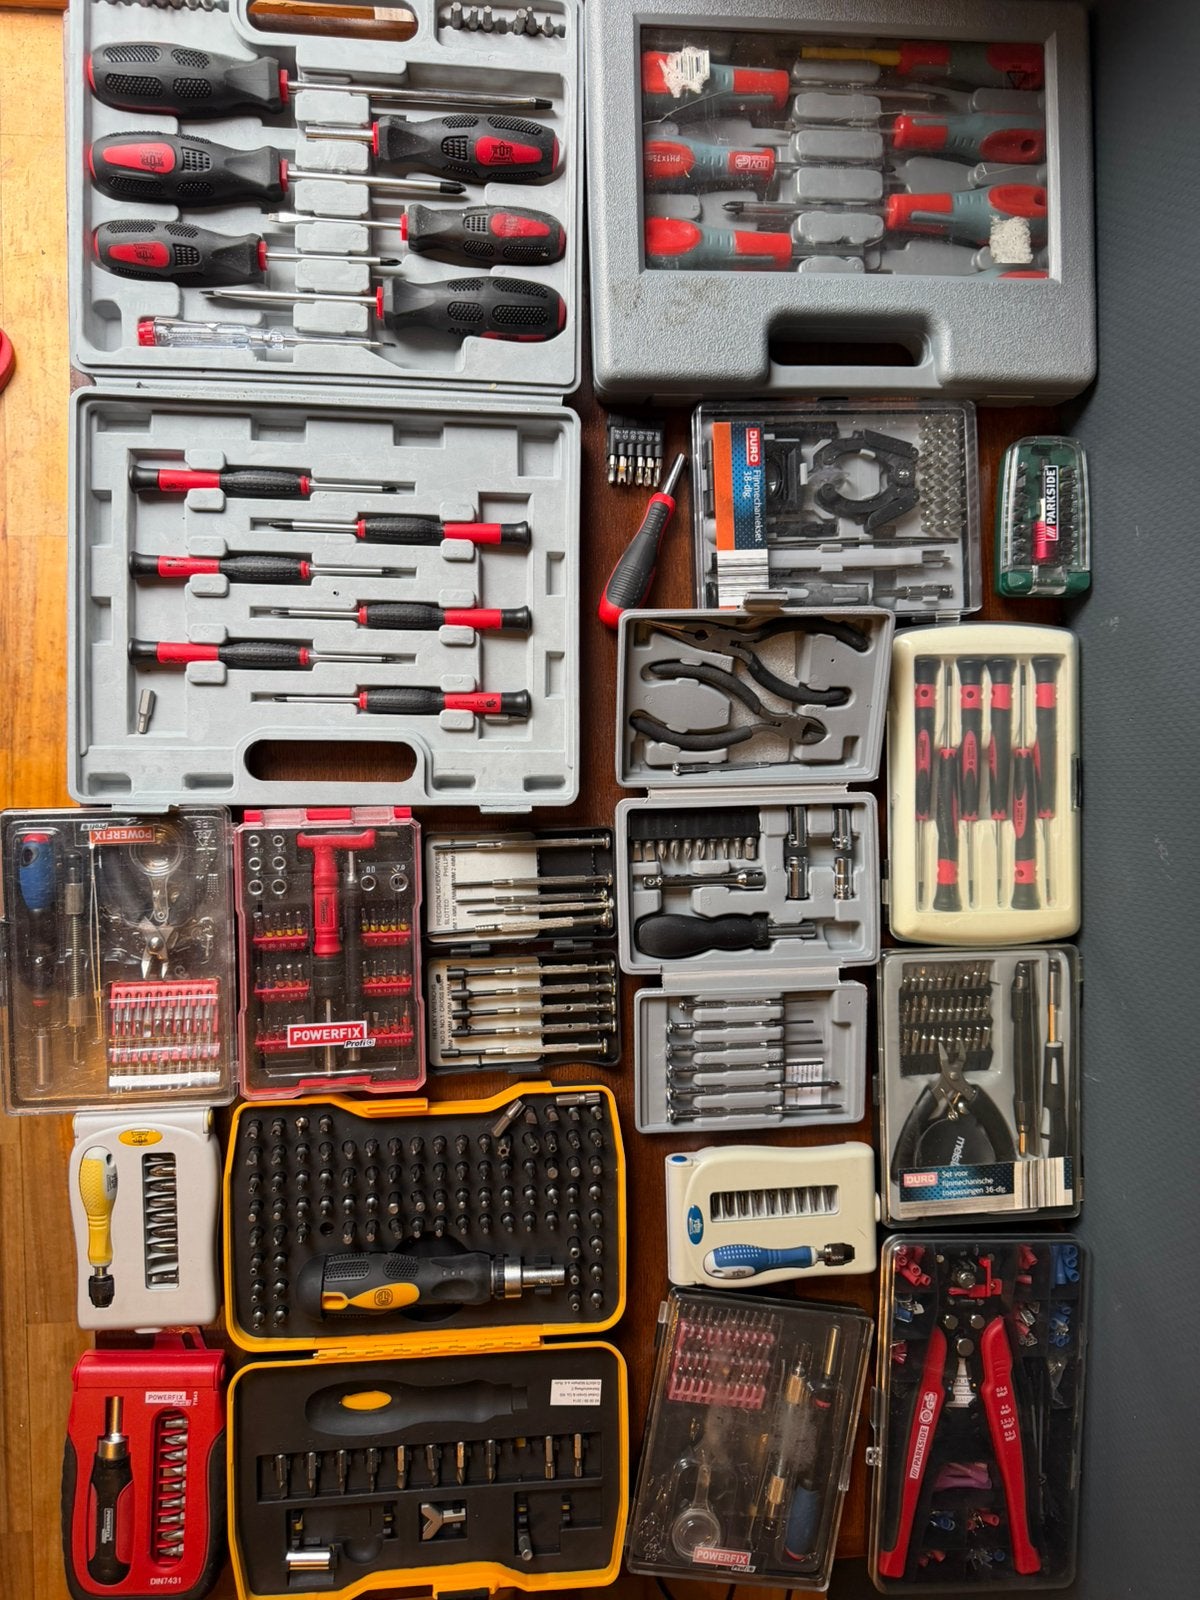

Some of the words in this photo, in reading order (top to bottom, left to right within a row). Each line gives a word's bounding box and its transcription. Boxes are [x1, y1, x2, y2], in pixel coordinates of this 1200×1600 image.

[749, 430, 759, 463] DURO
[1046, 469, 1056, 525] PARKSIDE
[753, 469, 763, 542] Fijnmechaniekset
[94, 829, 152, 840] POWERFIX
[293, 1026, 361, 1042] POWERFIX
[905, 1174, 936, 1185] DURO
[941, 1177, 994, 1188] fijnmechanische
[942, 1187, 984, 1197] toepassingen
[914, 1427, 928, 1467] PARKSIDE
[696, 1550, 748, 1564] POWERFIX
